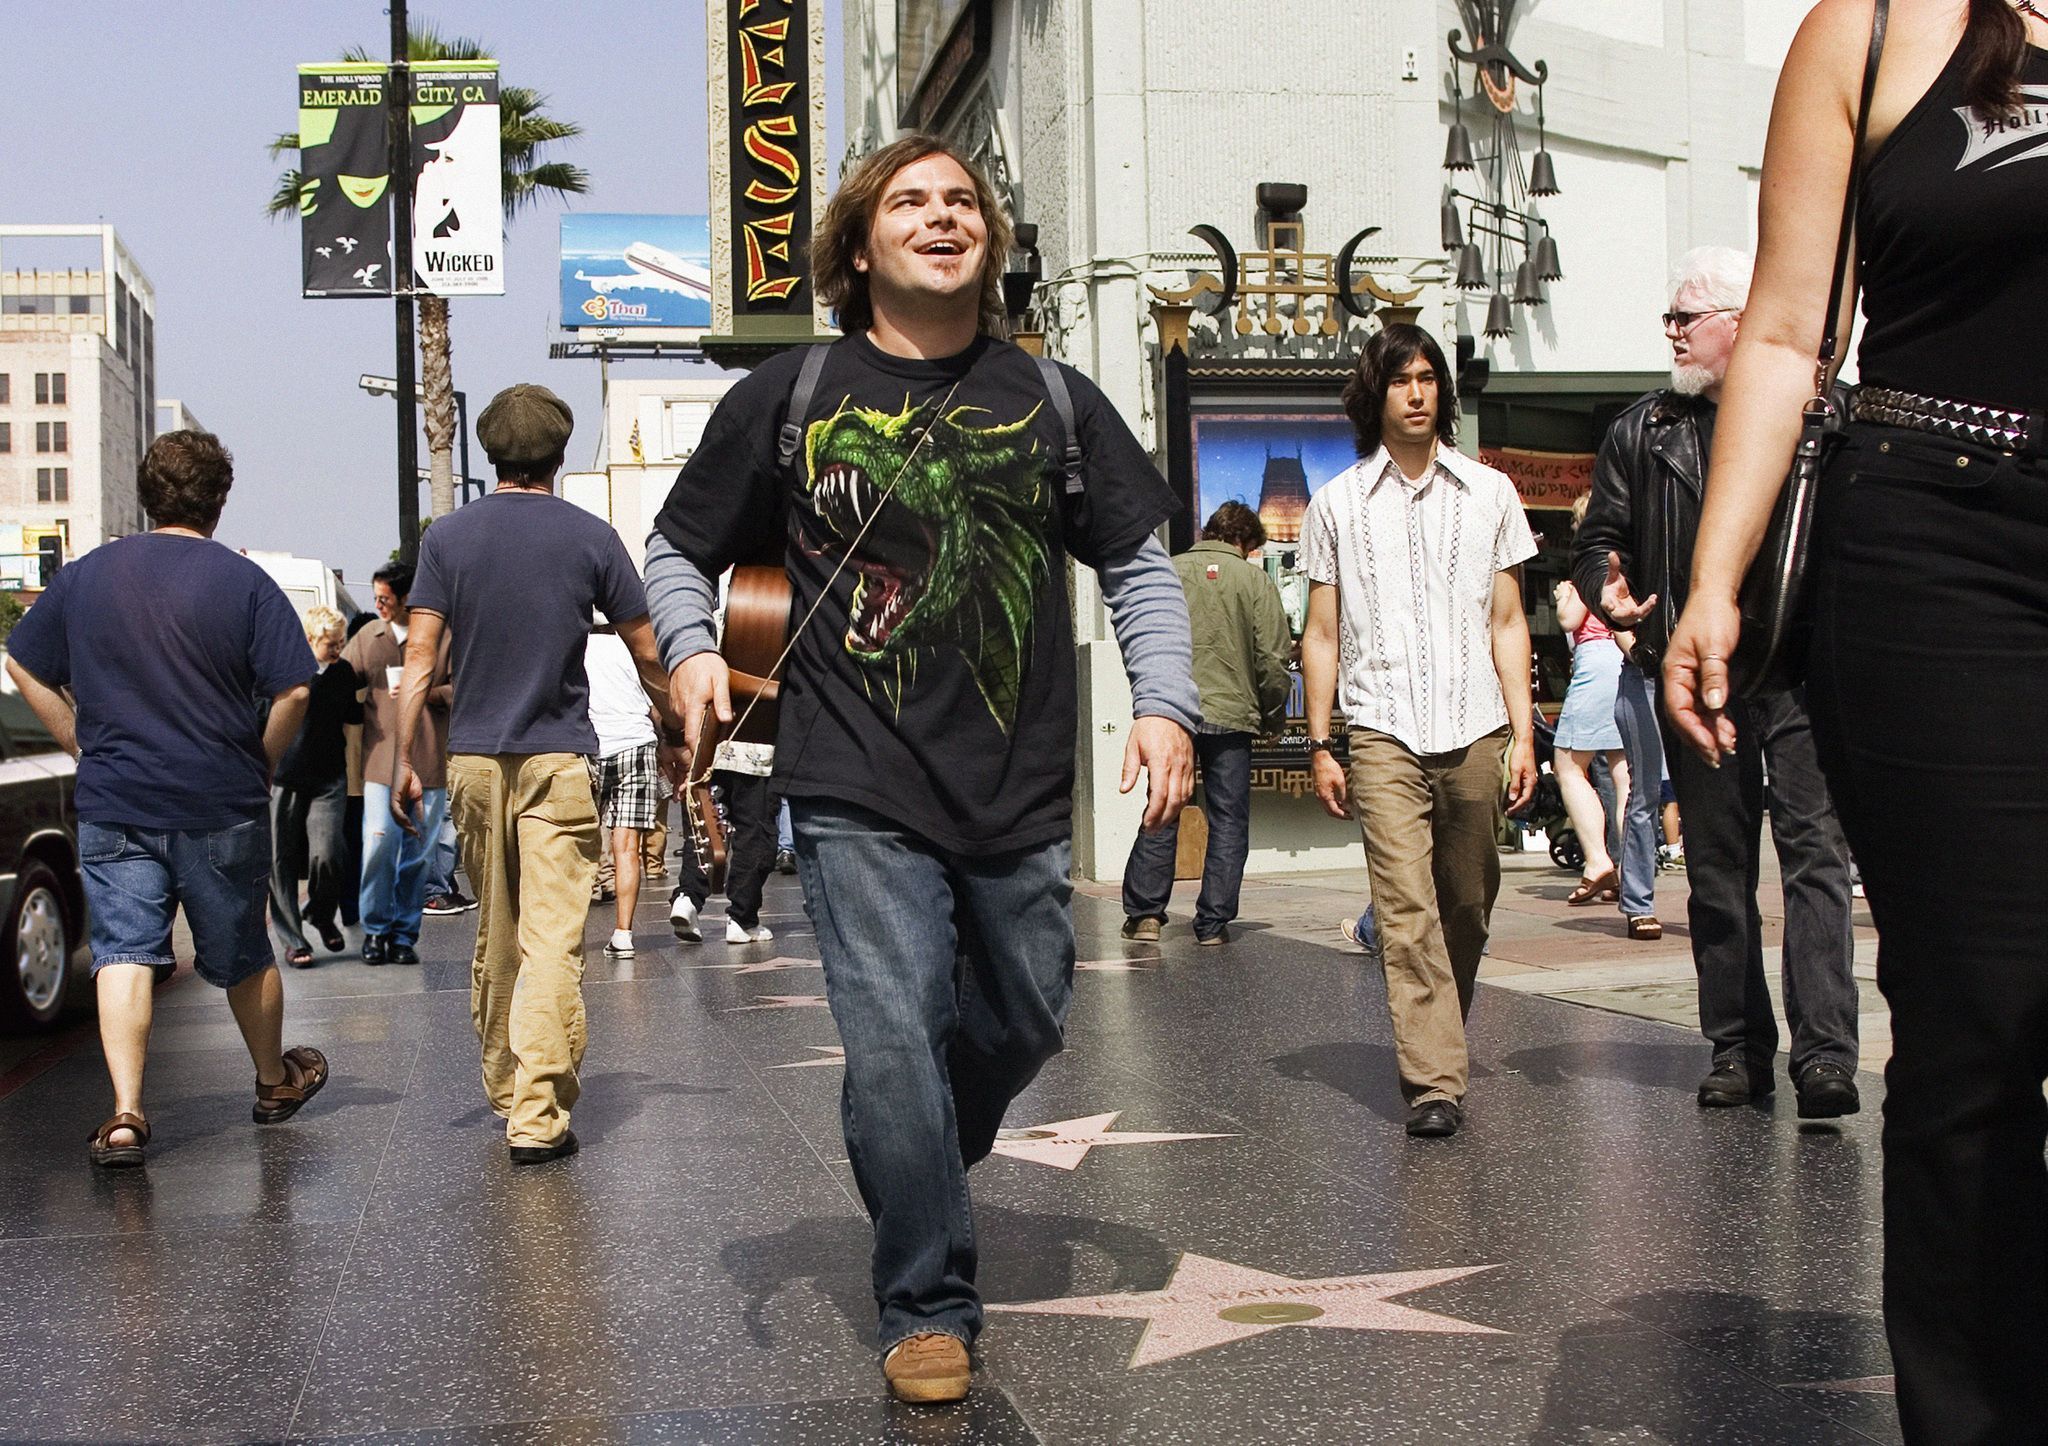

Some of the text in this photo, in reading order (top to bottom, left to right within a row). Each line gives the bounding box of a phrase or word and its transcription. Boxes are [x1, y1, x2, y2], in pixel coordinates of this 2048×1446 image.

[303, 89, 382, 106] EMERALD
[416, 86, 487, 105] CITY, CA
[1981, 108, 2048, 144] Holl
[738, 0, 801, 302] ESE
[610, 300, 645, 315] Thai
[1208, 1280, 1396, 1301] RATHBONE
